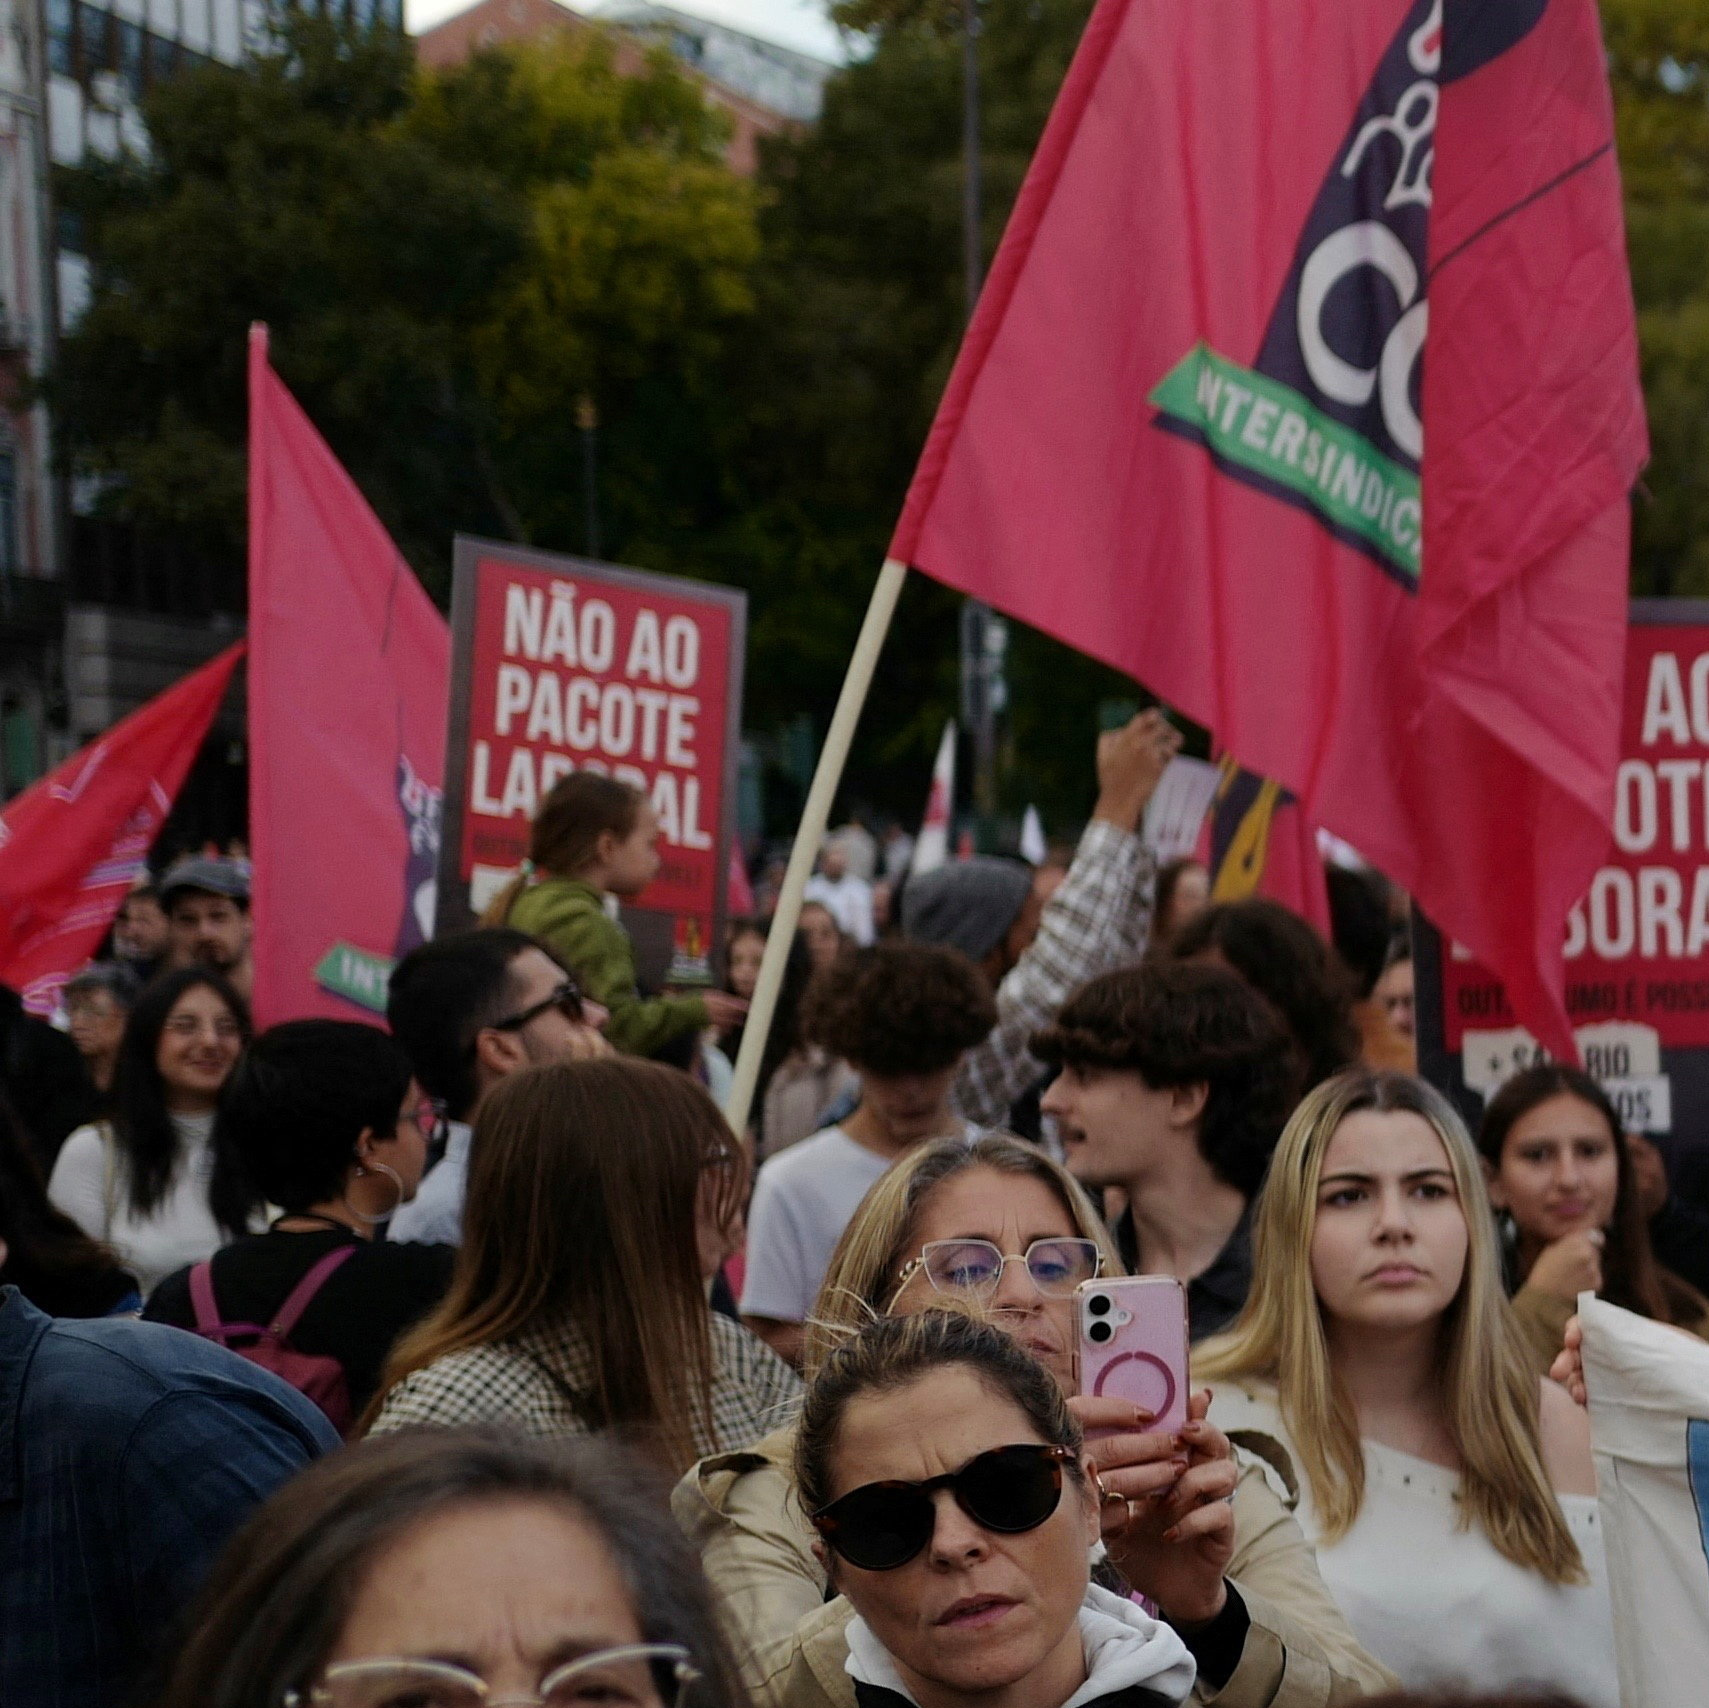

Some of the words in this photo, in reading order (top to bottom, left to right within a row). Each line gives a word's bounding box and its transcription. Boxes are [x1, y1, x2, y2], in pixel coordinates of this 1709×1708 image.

[504, 579, 616, 674] NÃO
[625, 608, 699, 689] AO
[495, 662, 701, 769] PACOTE
